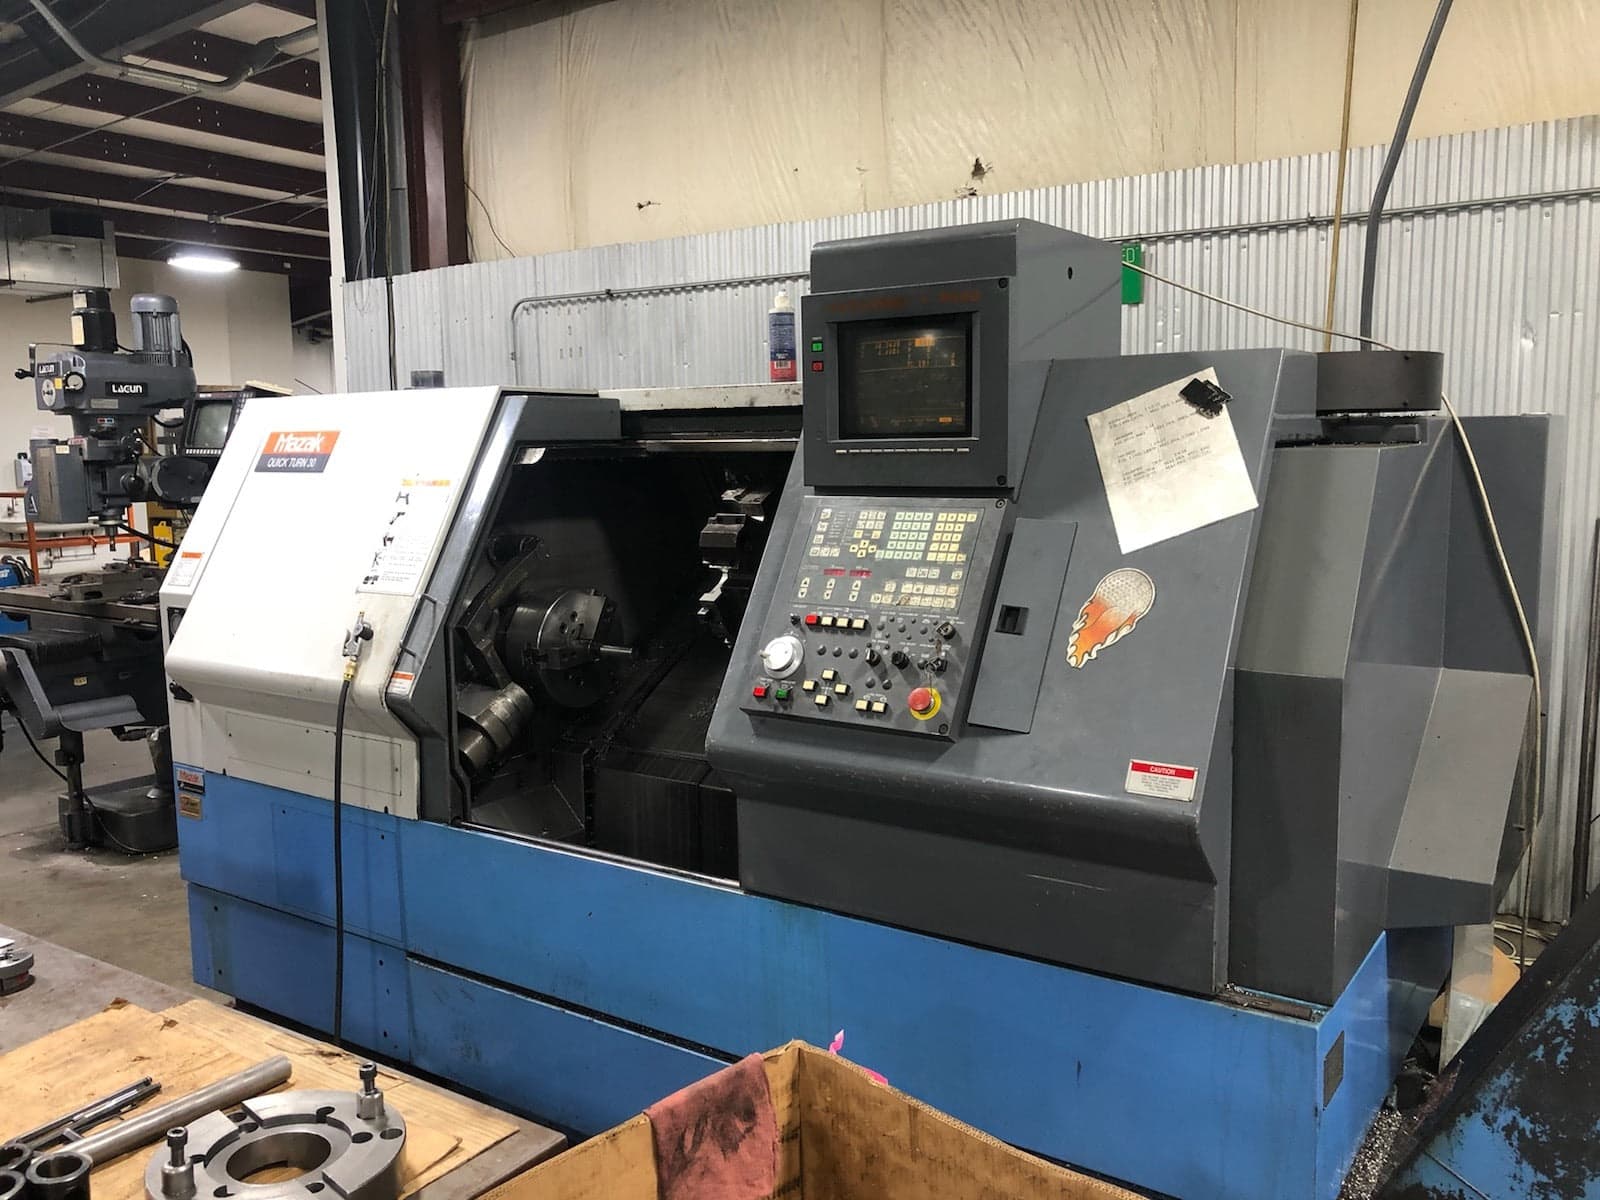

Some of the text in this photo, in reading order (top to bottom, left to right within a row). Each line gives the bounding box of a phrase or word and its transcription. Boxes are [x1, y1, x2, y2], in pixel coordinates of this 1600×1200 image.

[111, 384, 143, 394] LAGUN
[273, 432, 326, 453] Mazak
[267, 457, 290, 468] QUICK
[289, 457, 308, 468] TURN
